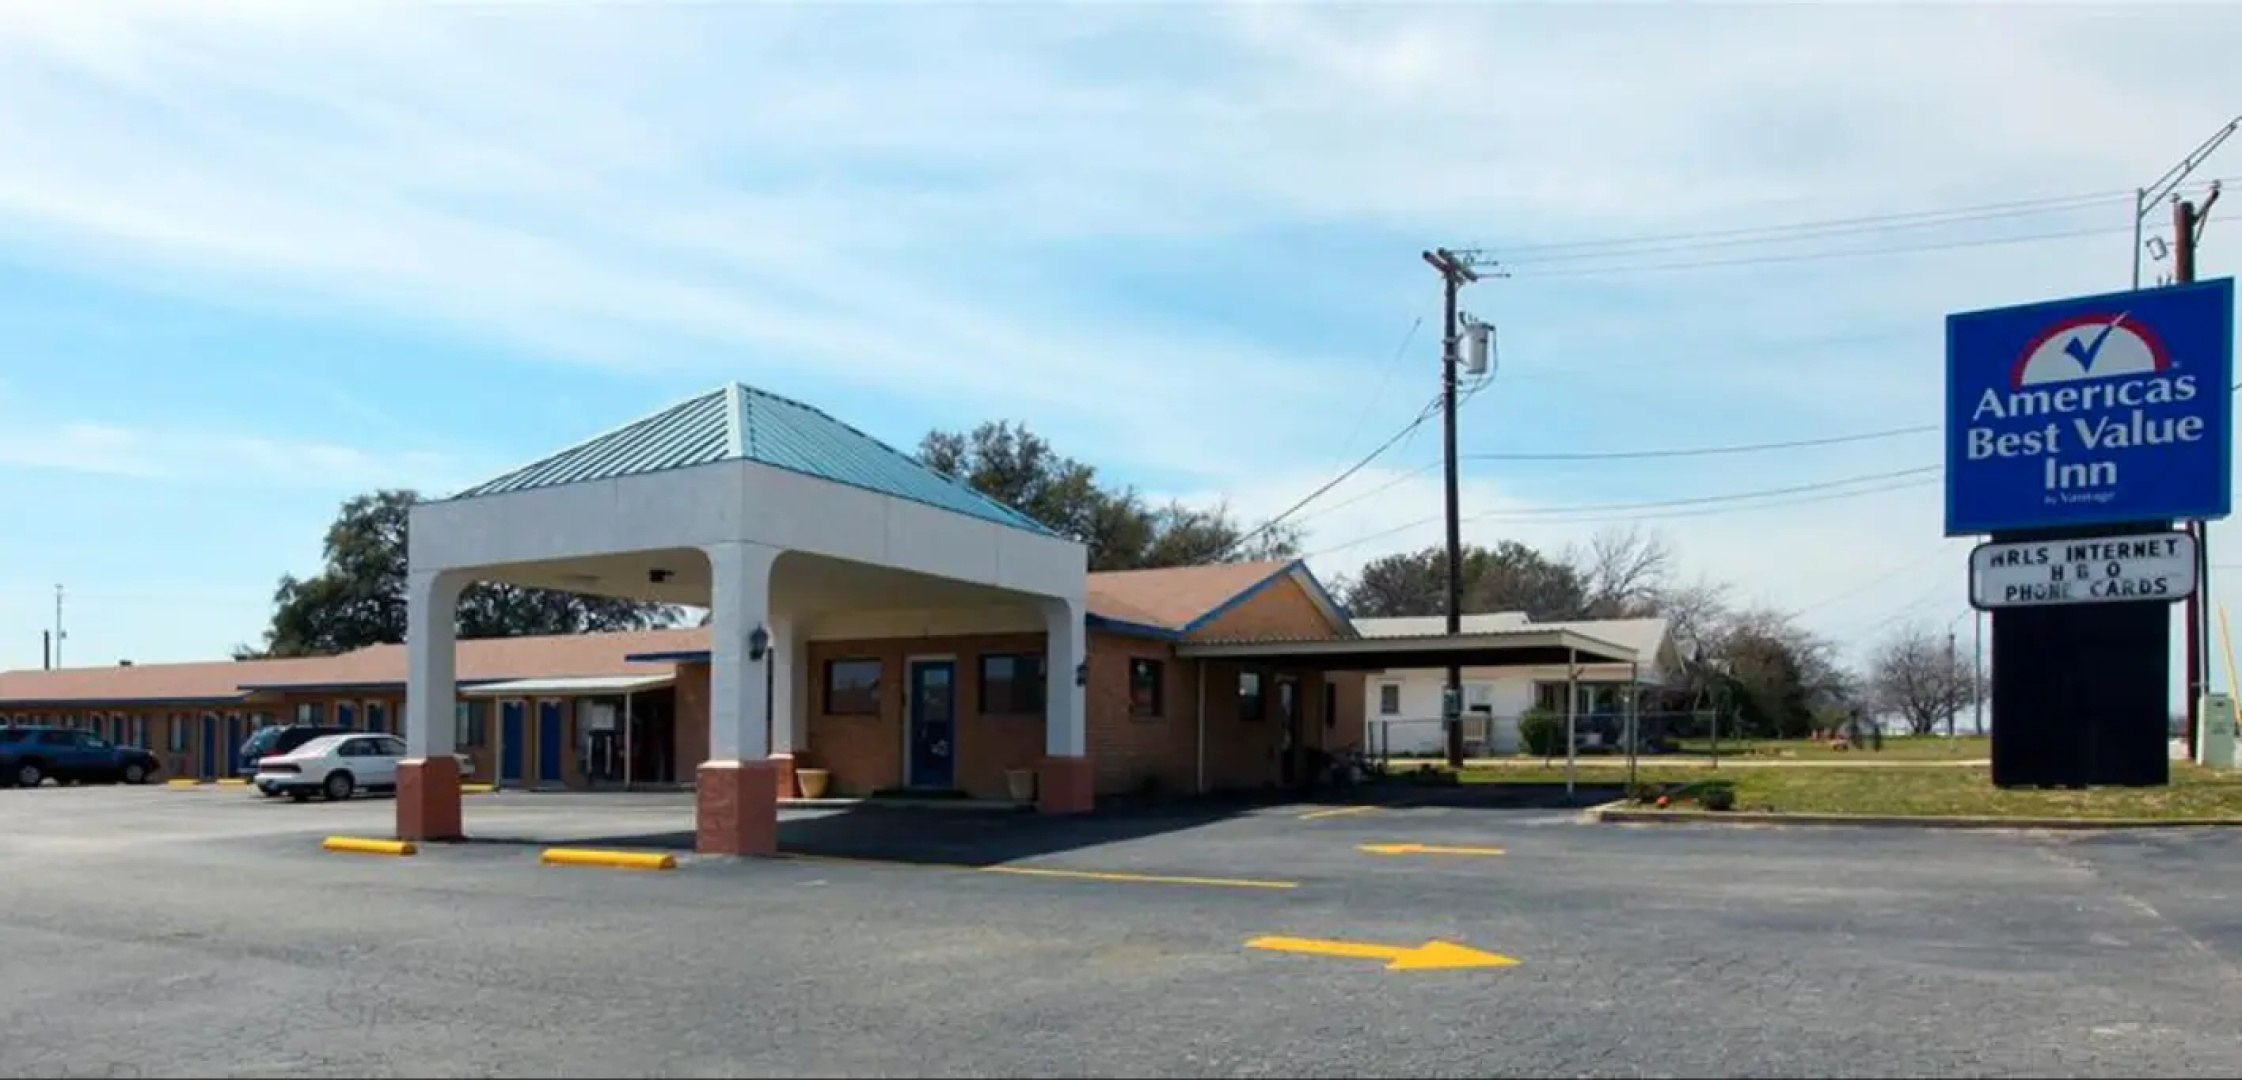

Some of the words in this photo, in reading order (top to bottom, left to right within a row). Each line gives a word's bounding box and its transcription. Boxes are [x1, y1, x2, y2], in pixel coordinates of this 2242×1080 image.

[1972, 374, 2197, 421] Americas
[1967, 422, 2061, 460] Best
[2073, 409, 2204, 450] Value
[2045, 457, 2117, 490] Inn
[2065, 539, 2177, 563] INTERNET
[2005, 583, 2073, 601] PHONE
[2089, 577, 2168, 597] CARDS
